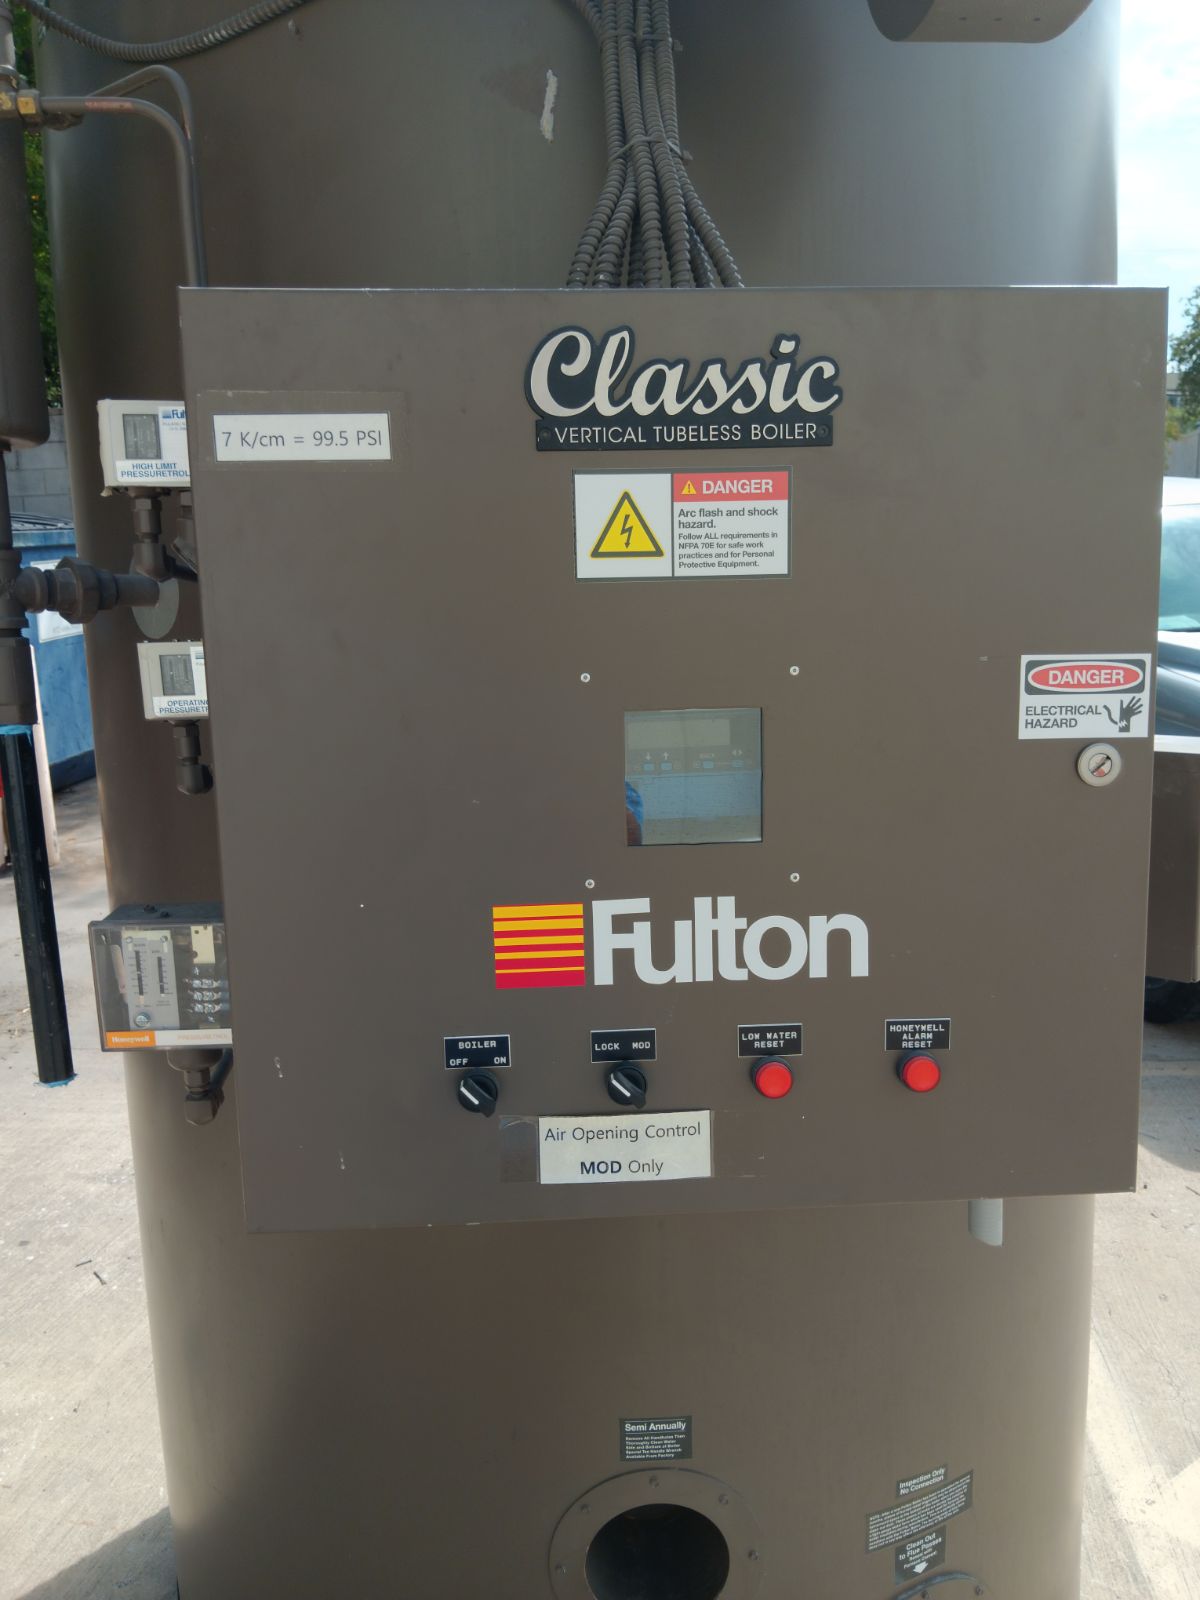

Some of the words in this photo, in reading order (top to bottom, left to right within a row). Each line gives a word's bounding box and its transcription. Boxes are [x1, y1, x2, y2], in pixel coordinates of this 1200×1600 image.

[530, 330, 839, 417] Classic
[554, 427, 647, 443] VERTICAL
[653, 425, 741, 442] TUBELESS
[751, 423, 817, 440] BOILER
[222, 432, 231, 447] 7
[240, 431, 285, 449] K/cm
[294, 435, 304, 443] =
[313, 430, 349, 447] 99.5
[357, 430, 382, 446] PSI
[121, 470, 190, 478] PRESSURETROL
[702, 479, 773, 494] DANGER
[678, 508, 697, 517] Arc
[699, 508, 723, 517] flash
[726, 507, 745, 517] and
[747, 507, 778, 516] shock
[678, 519, 716, 529] hazard.
[704, 532, 719, 540] ALL
[720, 531, 770, 540] requirements
[678, 542, 699, 550] NFPA
[716, 541, 727, 549] for
[728, 541, 744, 549] safe
[678, 551, 713, 560] practices
[742, 550, 775, 558] Personal
[678, 560, 716, 569] Protective
[717, 560, 760, 569] Equipment.
[1048, 669, 1125, 685] DANGER
[1025, 705, 1102, 716] ELECTRICAL
[1024, 718, 1078, 729] HAZARD
[592, 896, 869, 986] Fulton
[889, 1024, 945, 1032] HONEYWELL
[741, 1033, 760, 1041] LOW
[767, 1031, 797, 1040] WATER
[902, 1032, 933, 1040] ALARM
[458, 1040, 497, 1049] BOILER
[594, 1042, 620, 1051] LOCK
[632, 1041, 651, 1050] MOD
[754, 1040, 785, 1048] RESET
[901, 1040, 933, 1048] RESET
[449, 1058, 469, 1067] OFF
[493, 1056, 507, 1065] ON
[544, 1128, 566, 1141] Air
[572, 1126, 639, 1143] Opening
[645, 1122, 701, 1139] Control
[580, 1160, 622, 1175] MOD
[628, 1159, 664, 1176] Only
[624, 1423, 647, 1432] Semi
[649, 1421, 687, 1431] Annually
[900, 1473, 931, 1488] Inspection
[932, 1467, 946, 1477] Only
[900, 1488, 909, 1496] No
[910, 1475, 944, 1491] Connection
[906, 1539, 924, 1550] Clean
[925, 1532, 936, 1542] Out
